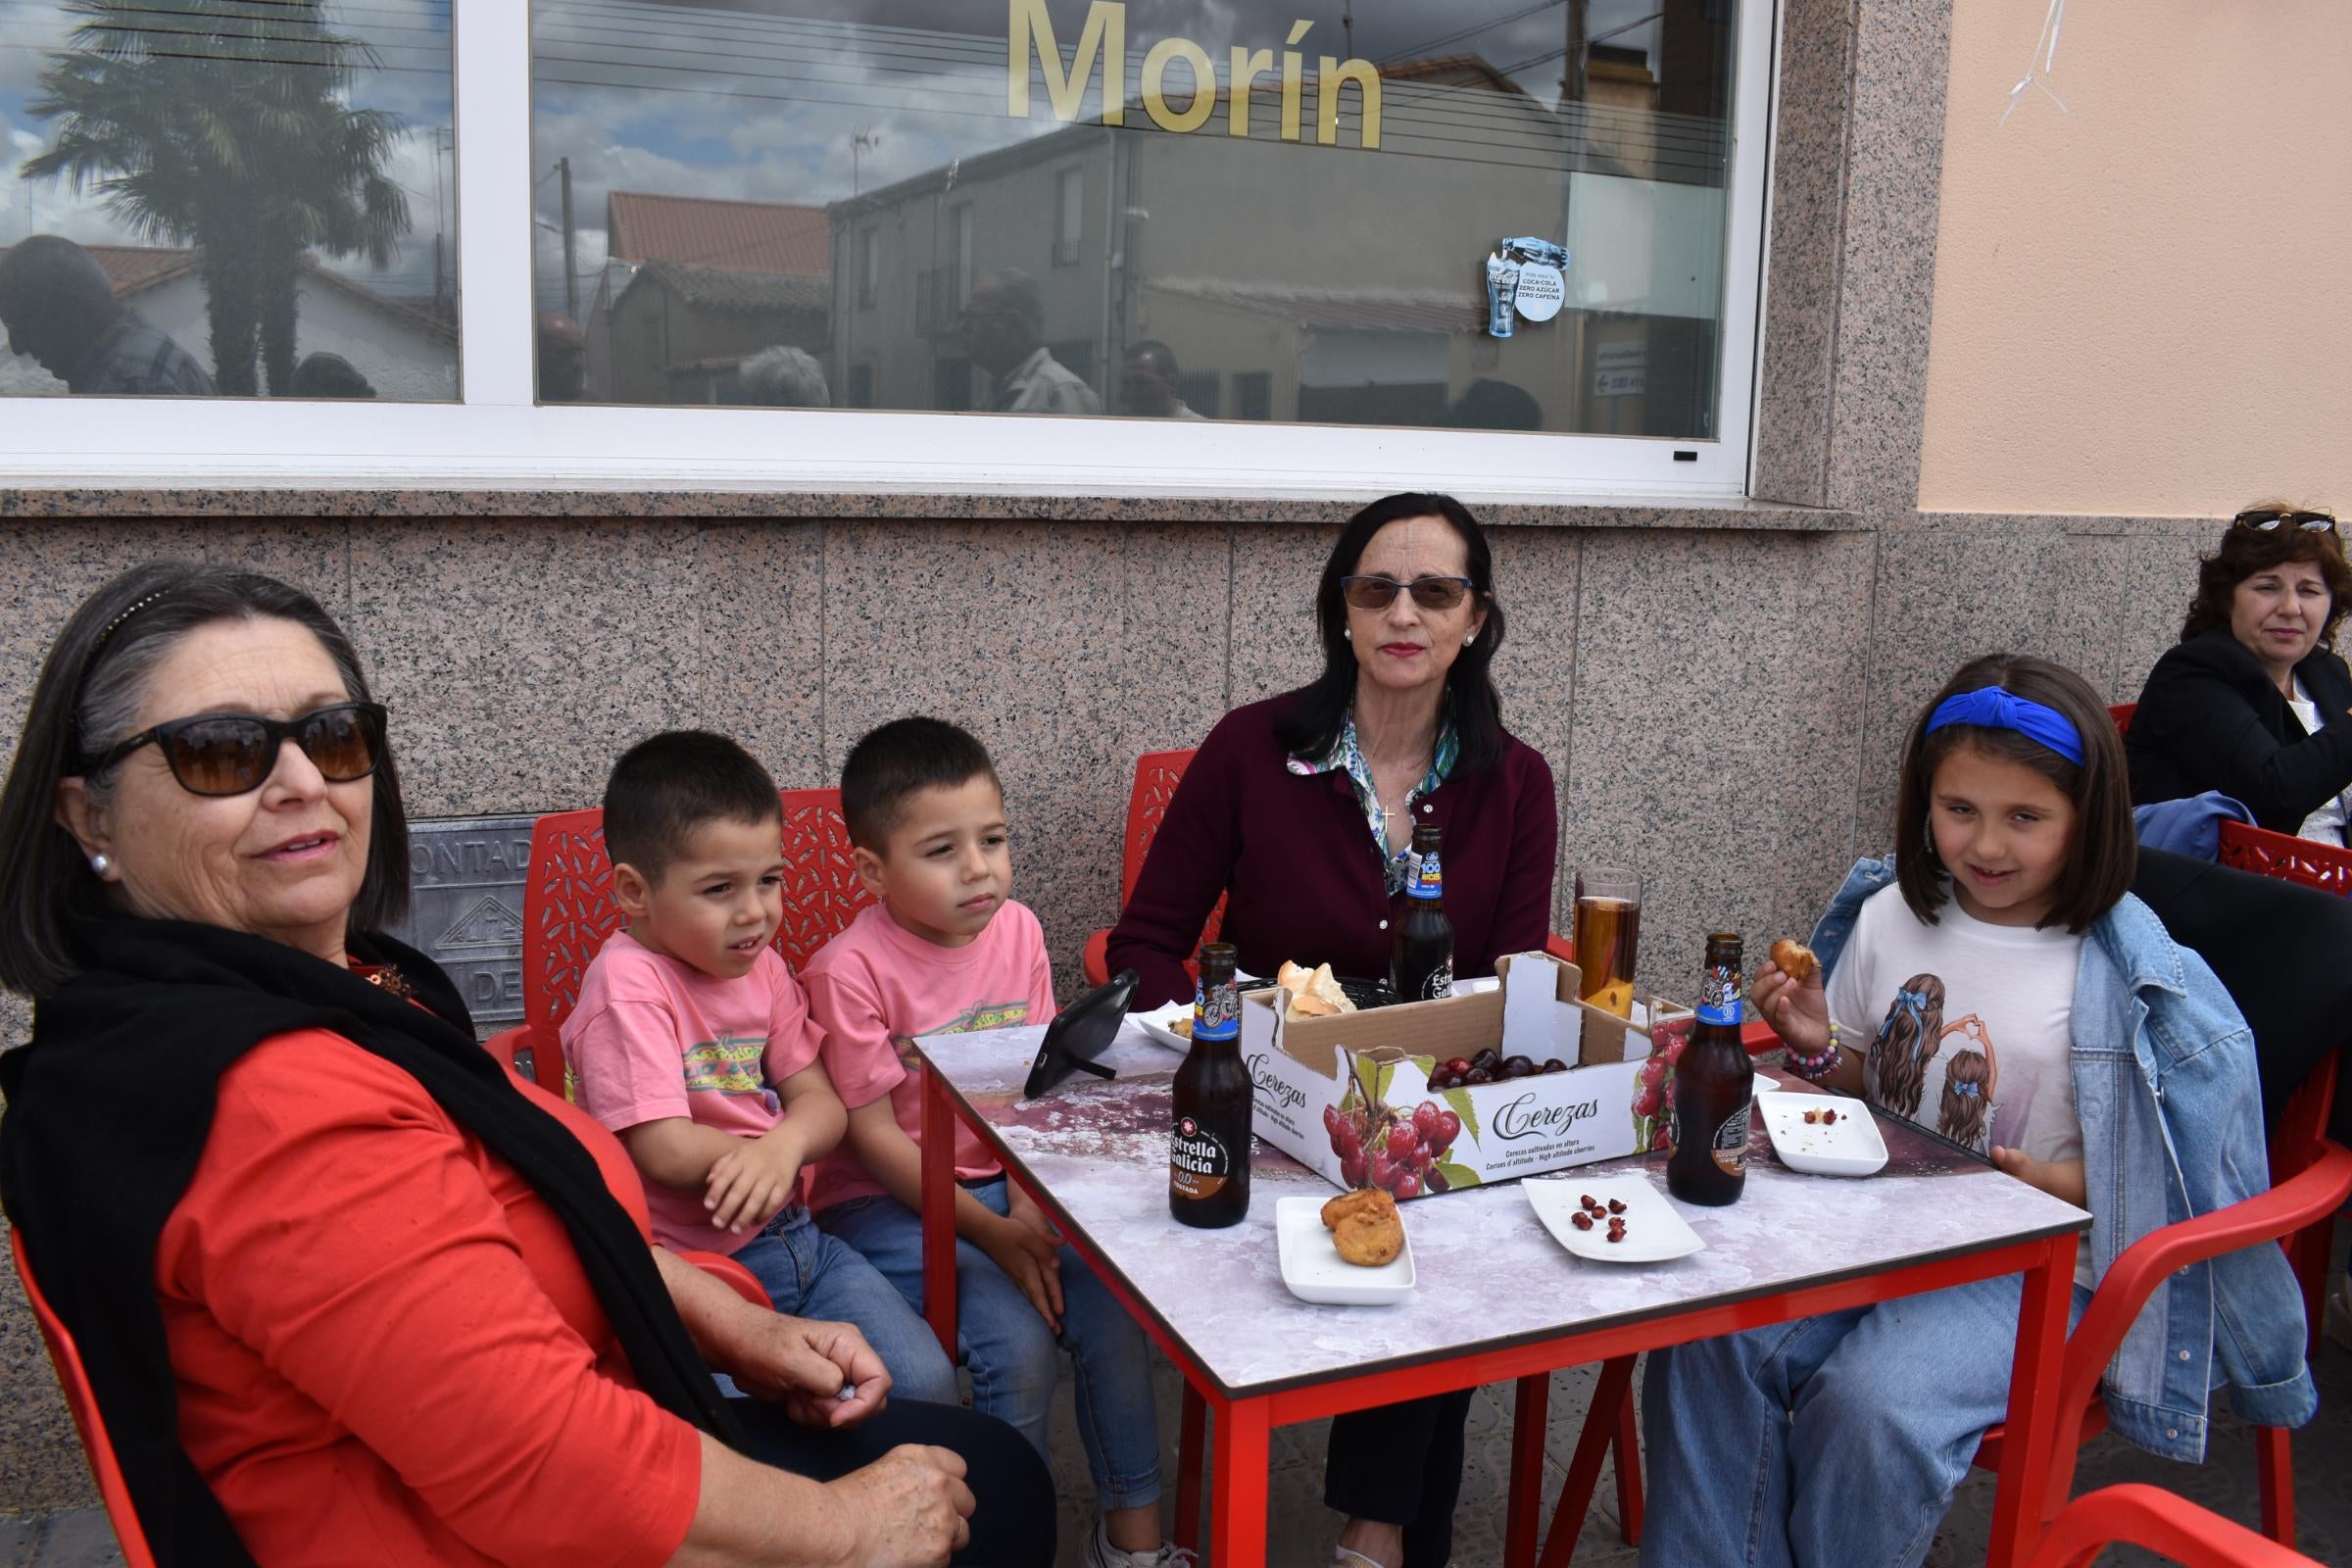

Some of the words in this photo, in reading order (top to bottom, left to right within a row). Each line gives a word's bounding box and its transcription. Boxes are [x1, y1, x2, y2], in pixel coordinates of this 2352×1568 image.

[1007, 0, 1383, 150] Morín
[410, 840, 533, 875] ONTAD
[1421, 862, 1441, 874] 100
[1246, 1054, 1307, 1108] Cerezas
[1493, 1093, 1598, 1141] Cerezas
[1486, 1161, 1506, 1170] Cerises
[1539, 1152, 1551, 1161] High
[1552, 1149, 1573, 1158] altitude
[1574, 1145, 1595, 1154] cherries
[1505, 1149, 1527, 1157] Cerezas
[1528, 1144, 1554, 1153] cultivadas
[1563, 1139, 1580, 1148] altura
